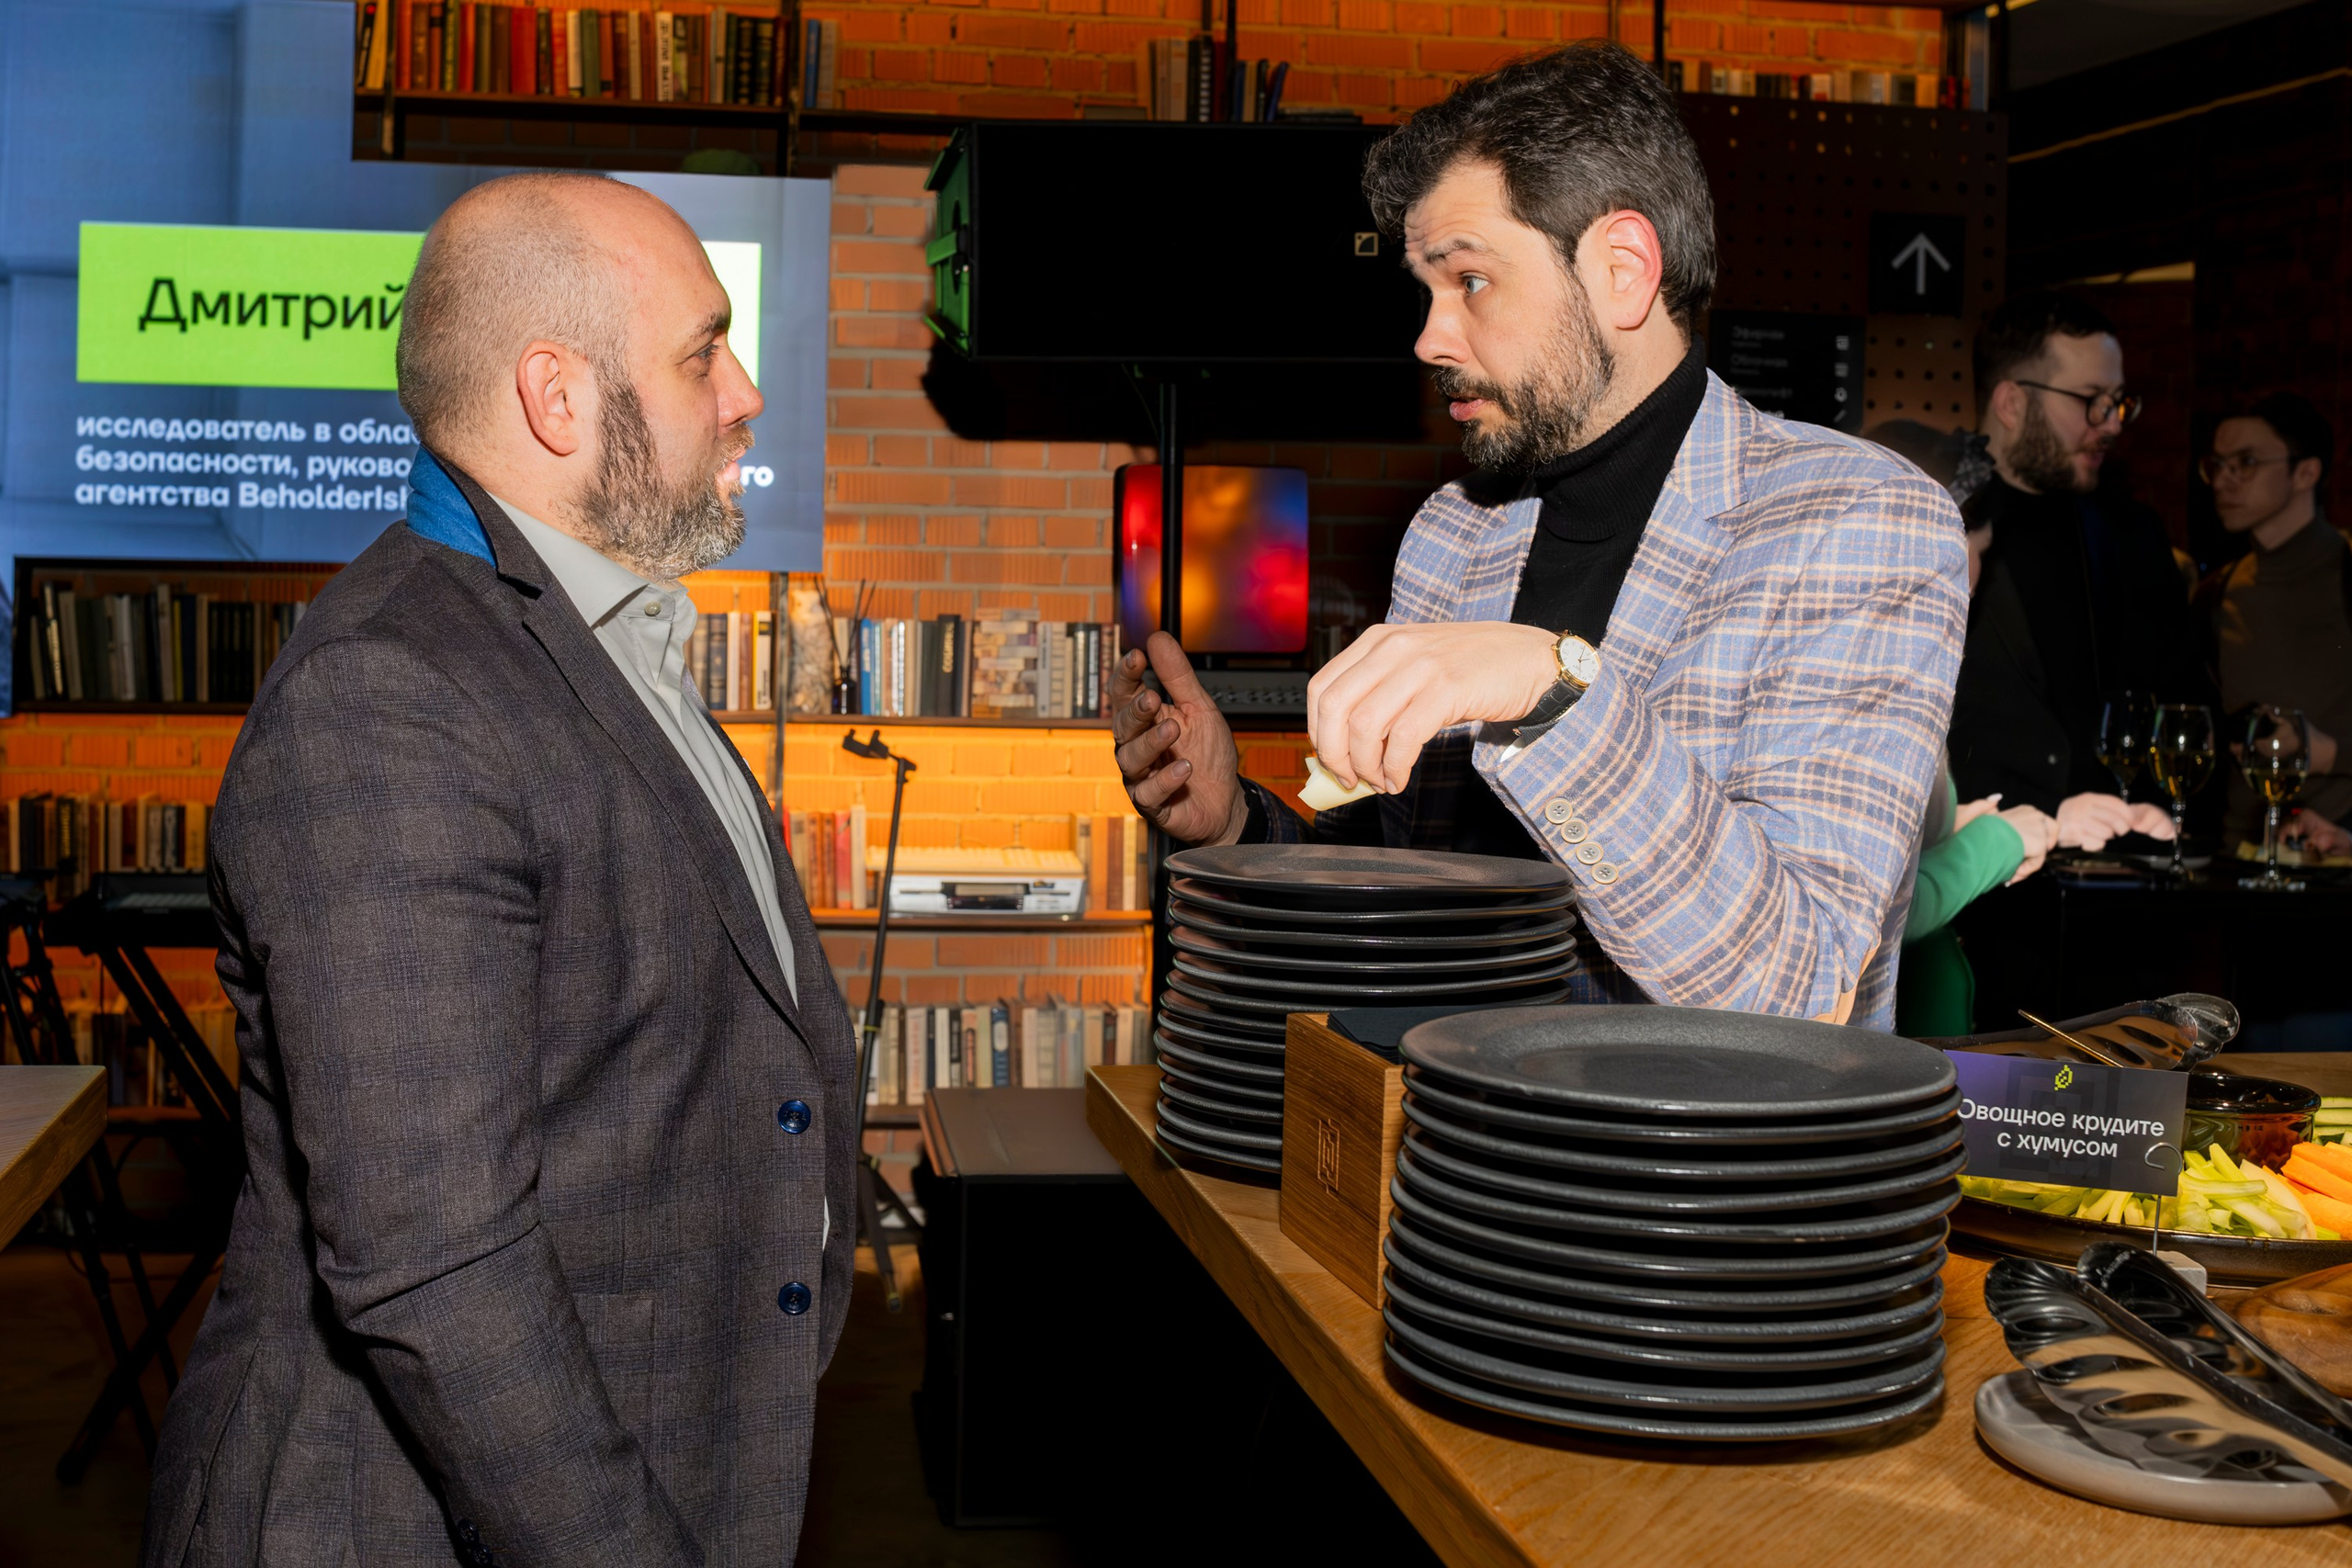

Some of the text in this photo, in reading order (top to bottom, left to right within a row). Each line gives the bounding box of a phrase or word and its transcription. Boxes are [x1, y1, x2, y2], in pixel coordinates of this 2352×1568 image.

[139, 277, 404, 341] Дмитрий
[75, 416, 307, 443] исследователь
[313, 422, 332, 443] в
[75, 445, 300, 479] безопасности,
[74, 483, 230, 507] агентства
[1957, 1099, 2165, 1137] Овощное крудите
[1996, 1132, 2119, 1158] с хумусом
